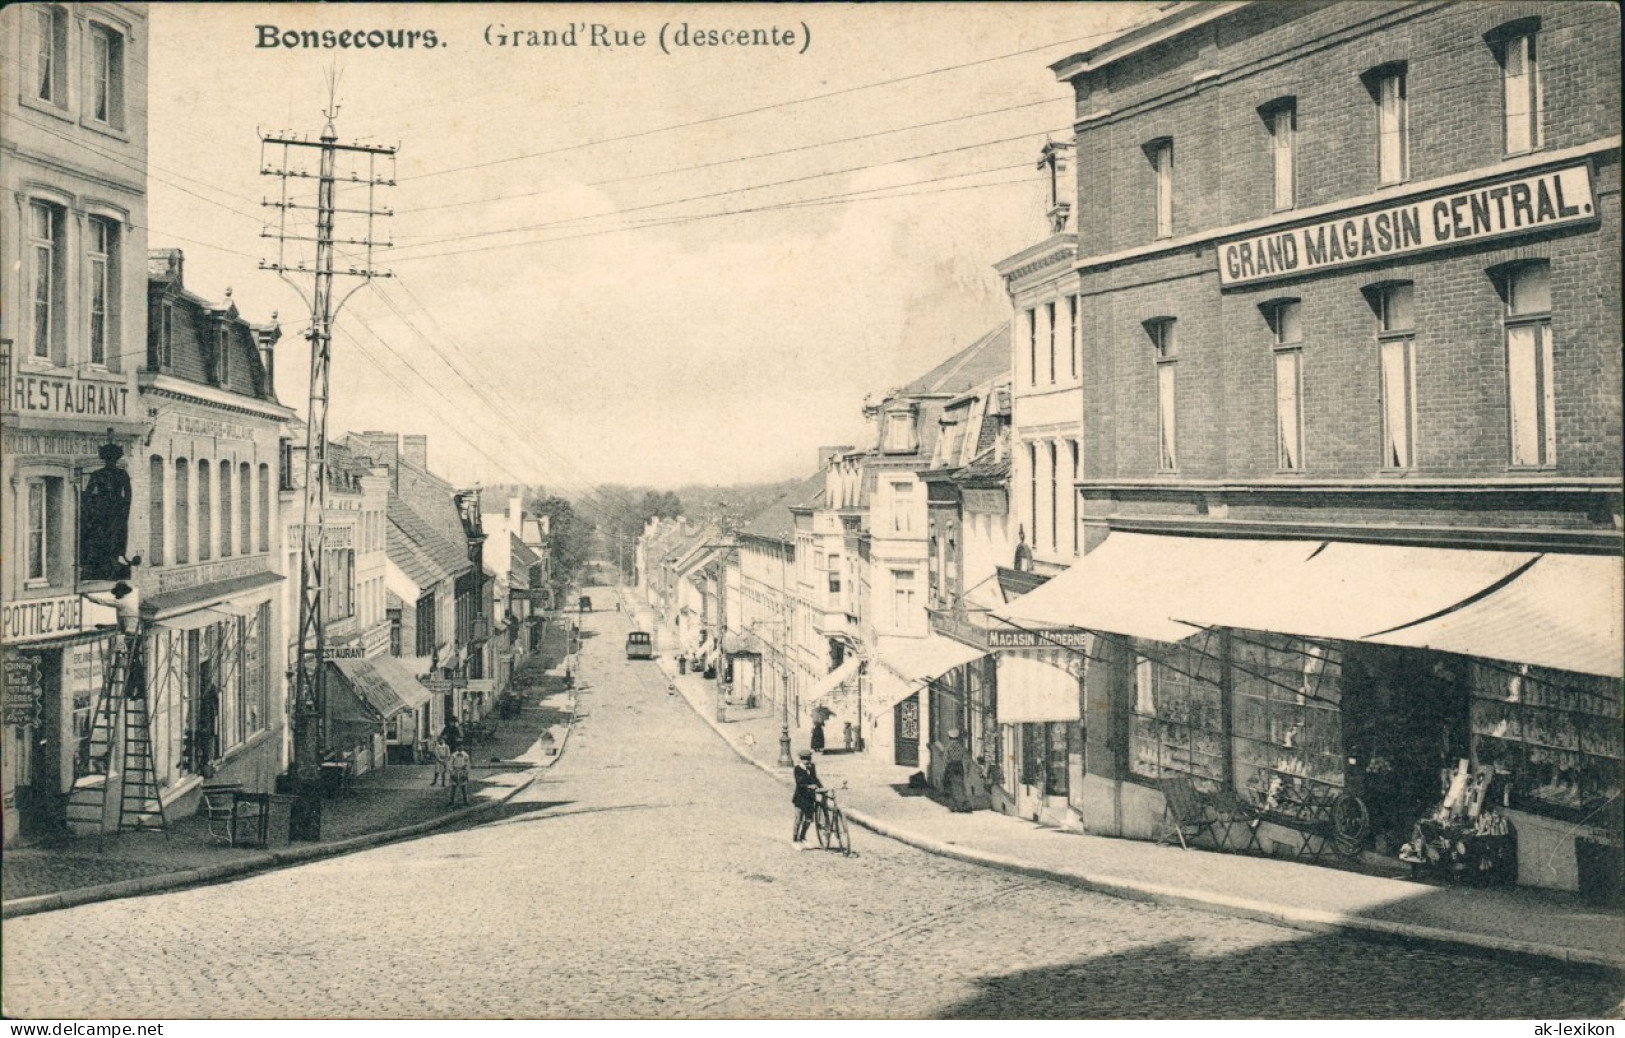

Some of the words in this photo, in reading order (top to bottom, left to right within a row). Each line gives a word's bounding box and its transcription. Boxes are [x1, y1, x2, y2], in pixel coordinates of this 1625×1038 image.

[1226, 233, 1298, 280] GRAND
[1304, 206, 1422, 266] MAGASIN
[1433, 173, 1593, 242] CENTRAL.
[14, 377, 129, 416] RESTAURANT
[3, 601, 54, 638] POTTIEZ
[989, 630, 1035, 646] MAGASIN
[1039, 630, 1086, 646] MODERNE
